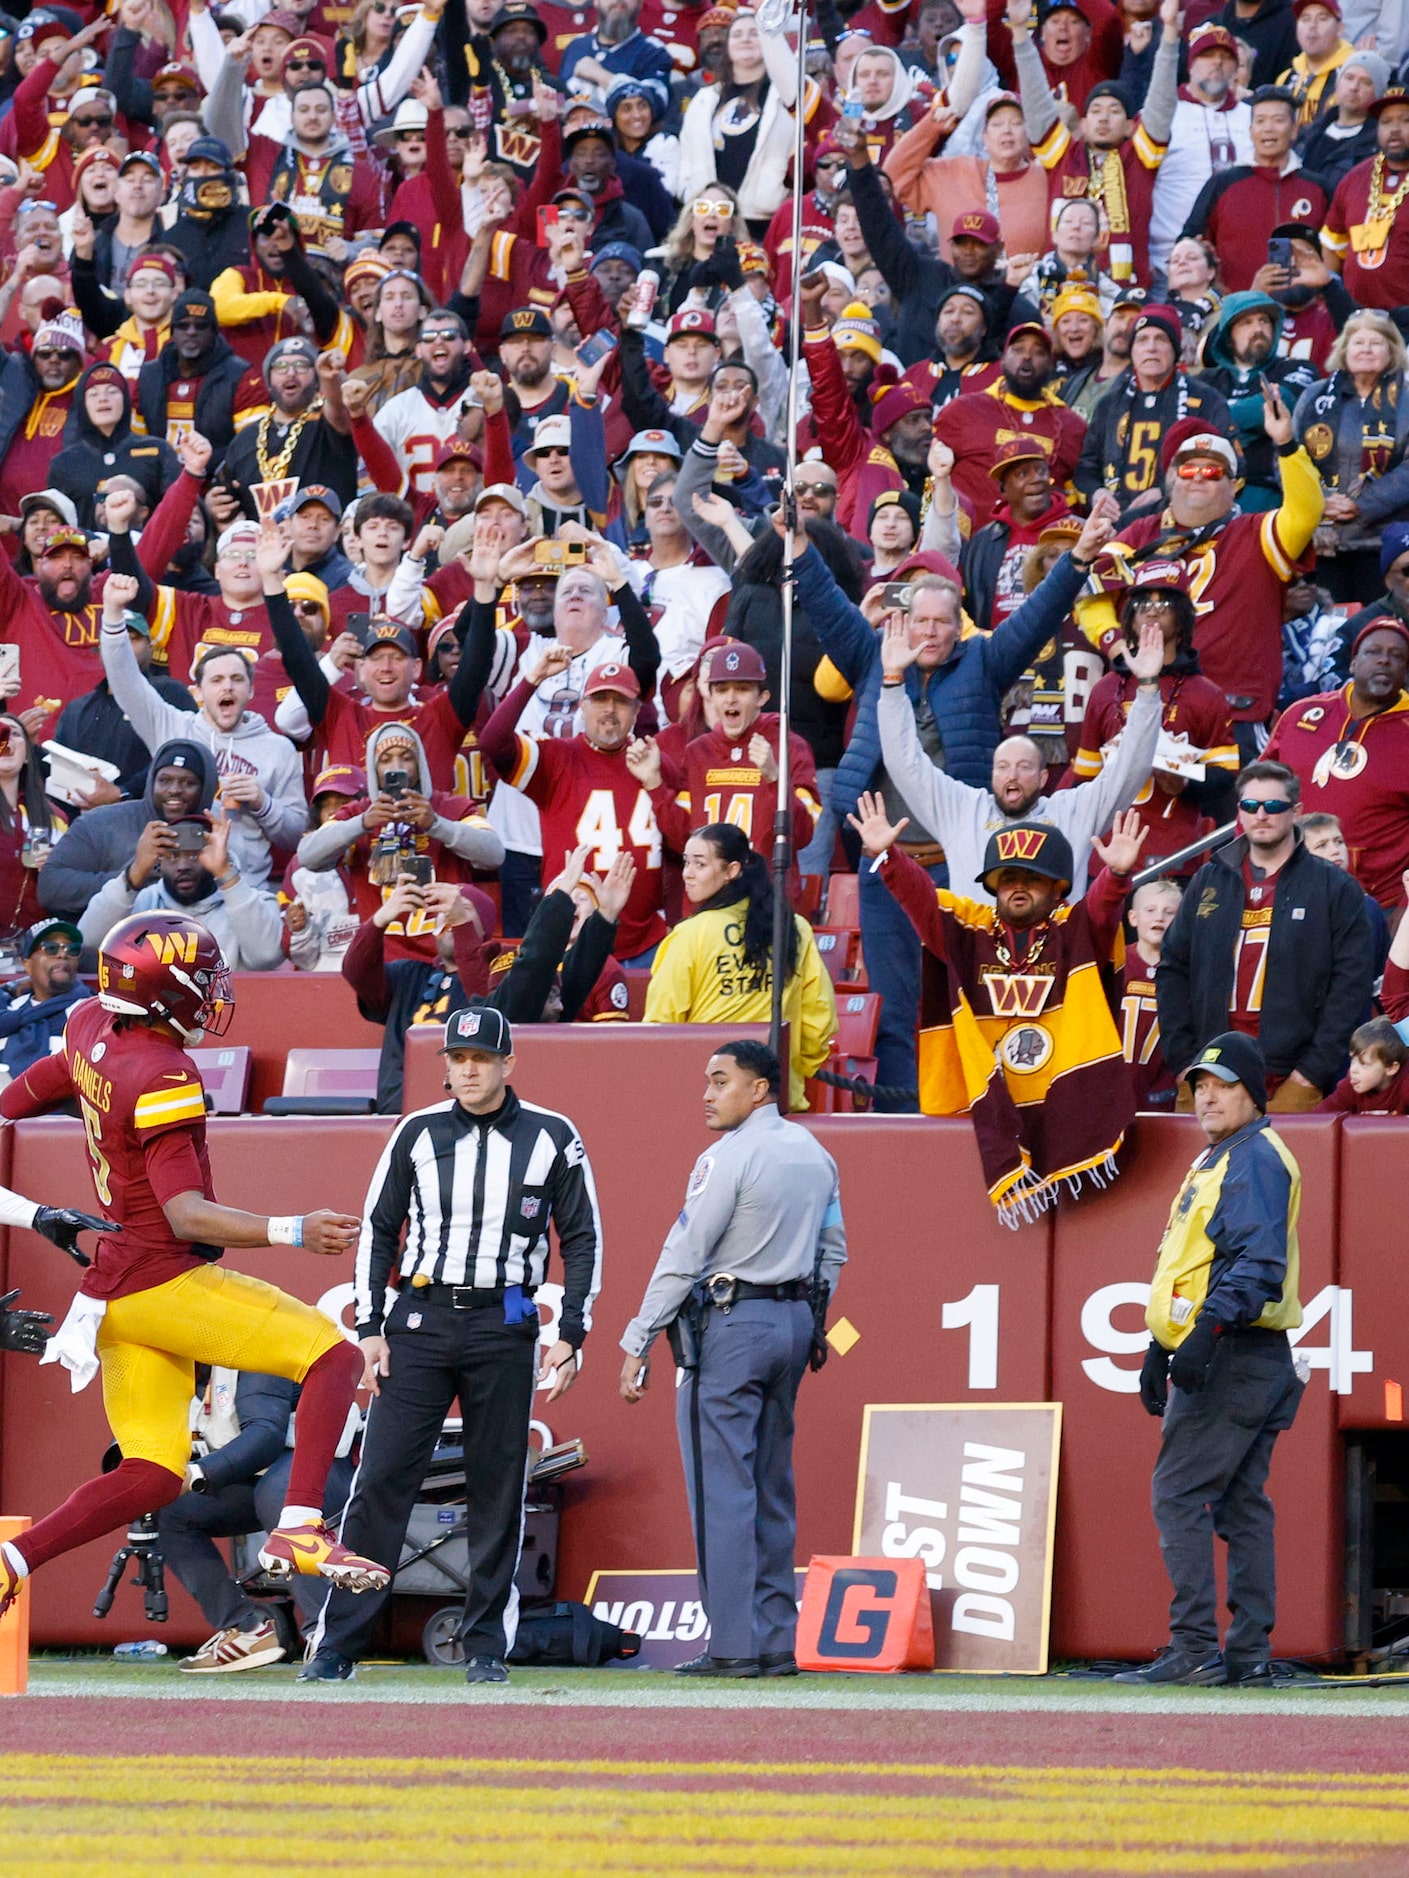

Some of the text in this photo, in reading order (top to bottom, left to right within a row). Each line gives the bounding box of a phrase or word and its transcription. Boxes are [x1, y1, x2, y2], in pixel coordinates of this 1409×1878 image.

[495, 124, 541, 167] W
[404, 434, 438, 494] 2
[1125, 422, 1161, 491] 5
[576, 788, 663, 871] 44
[996, 829, 1047, 861] W
[102, 966, 110, 988] 5
[146, 932, 199, 964] W
[719, 975, 775, 997] STAF
[983, 974, 1056, 1017] W
[72, 1050, 113, 1114] DANIELS
[80, 1096, 113, 1206] 5
[882, 1482, 947, 1590] ST
[952, 1441, 1026, 1641] DOWN
[816, 1568, 897, 1659] G
